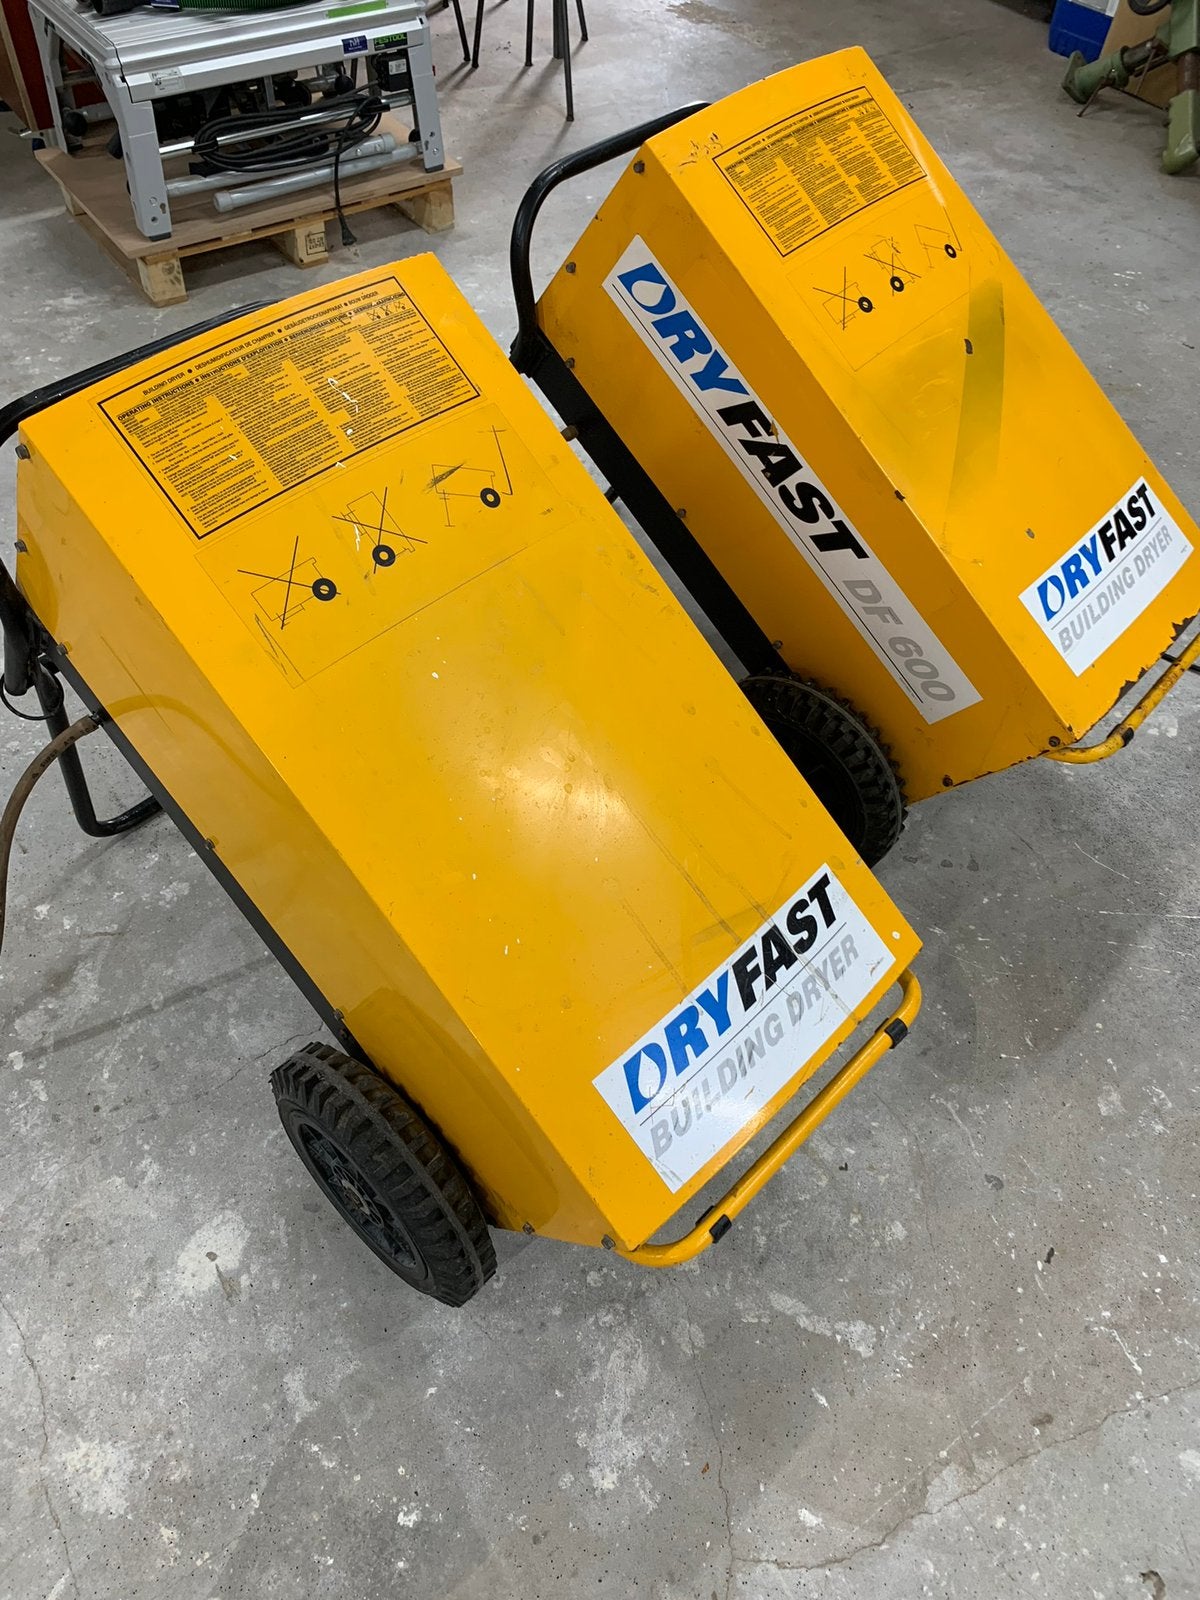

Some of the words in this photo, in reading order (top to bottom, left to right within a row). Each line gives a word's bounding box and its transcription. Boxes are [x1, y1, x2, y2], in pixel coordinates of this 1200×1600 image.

[374, 33, 407, 45] FESTOOL
[117, 401, 152, 421] OPERATING
[151, 380, 195, 404] INSTRUCTIONS
[199, 358, 241, 380] INSTRUCTIONS
[142, 380, 168, 395] BUILDING
[167, 371, 186, 384] DRYER
[251, 330, 276, 344] CHANTIER
[617, 262, 870, 559] DRYFAST
[1036, 482, 1156, 622] DRYFAST
[1057, 566, 1136, 653] BUILDING
[1132, 525, 1173, 577] DRYER
[842, 579, 903, 626] DF
[888, 634, 956, 702] 600
[622, 872, 838, 1115] DRYFAST
[649, 1013, 784, 1159] BUILDING
[786, 934, 859, 1027] DRYER
